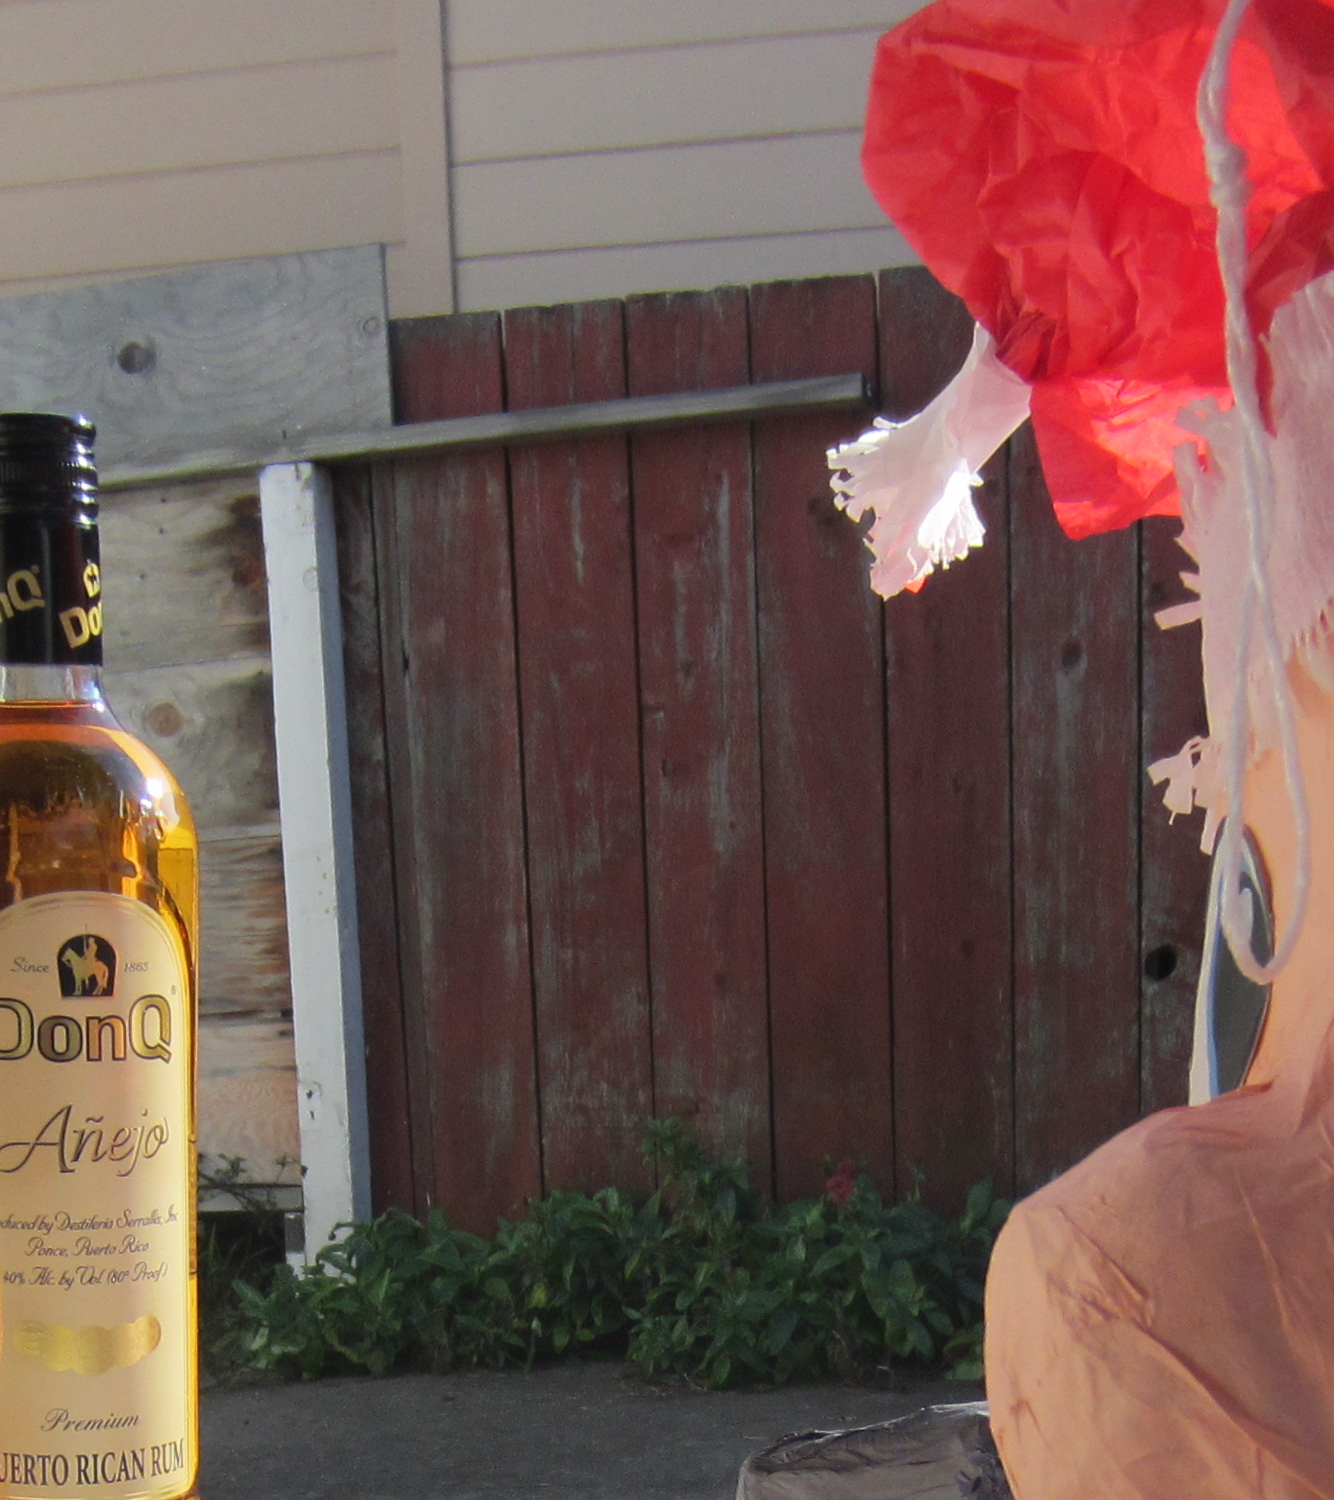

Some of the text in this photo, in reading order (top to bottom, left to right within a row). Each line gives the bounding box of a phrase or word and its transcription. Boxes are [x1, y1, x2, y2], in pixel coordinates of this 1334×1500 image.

[10, 956, 50, 974] Since
[38, 1214, 54, 1236] by
[25, 1233, 150, 1258] Ponce, Puerto Rico
[3, 1270, 26, 1286] 40%
[58, 1270, 76, 1292] by
[39, 1407, 142, 1434] Premium
[75, 1447, 146, 1487] RICAN
[151, 1437, 185, 1478] RUM
